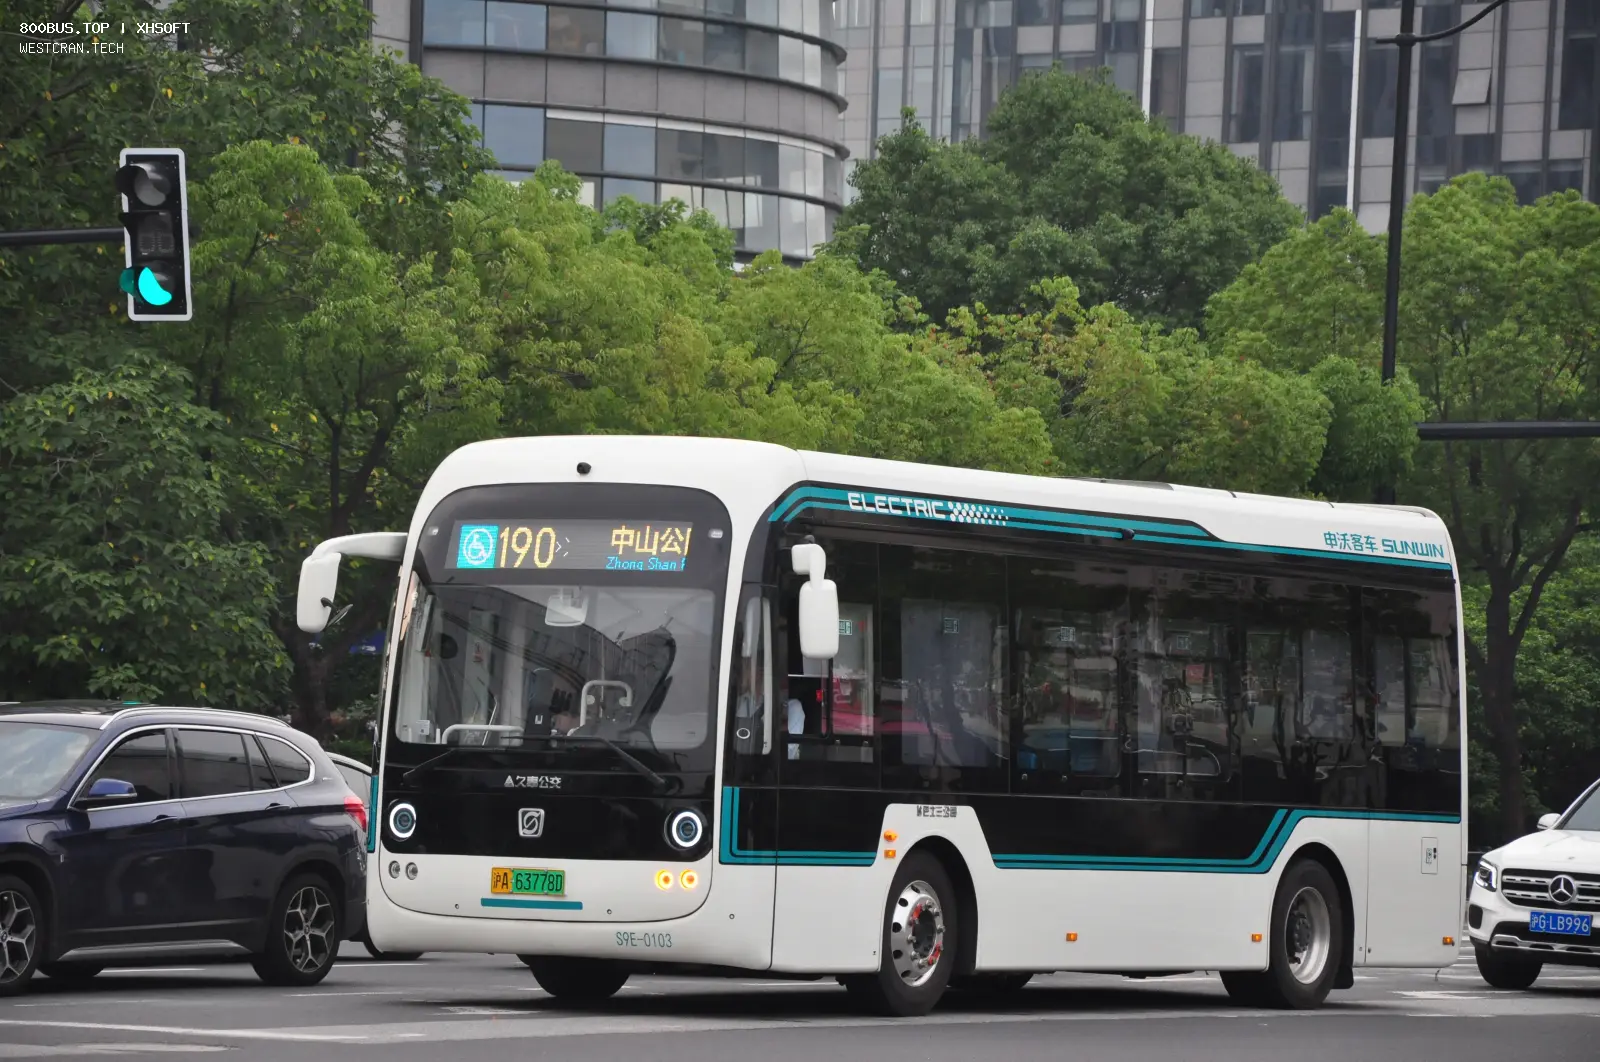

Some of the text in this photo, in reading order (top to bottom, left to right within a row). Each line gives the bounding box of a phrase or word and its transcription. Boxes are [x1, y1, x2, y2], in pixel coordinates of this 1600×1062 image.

[847, 492, 946, 519] ELECTRIC
[500, 526, 556, 568] 190
[611, 525, 692, 556] 中山公
[1323, 531, 1445, 558] 申沃客车 SUNWIN
[605, 556, 643, 571] Zhong
[648, 557, 676, 570] Shan
[615, 931, 672, 948] S9E-0103
